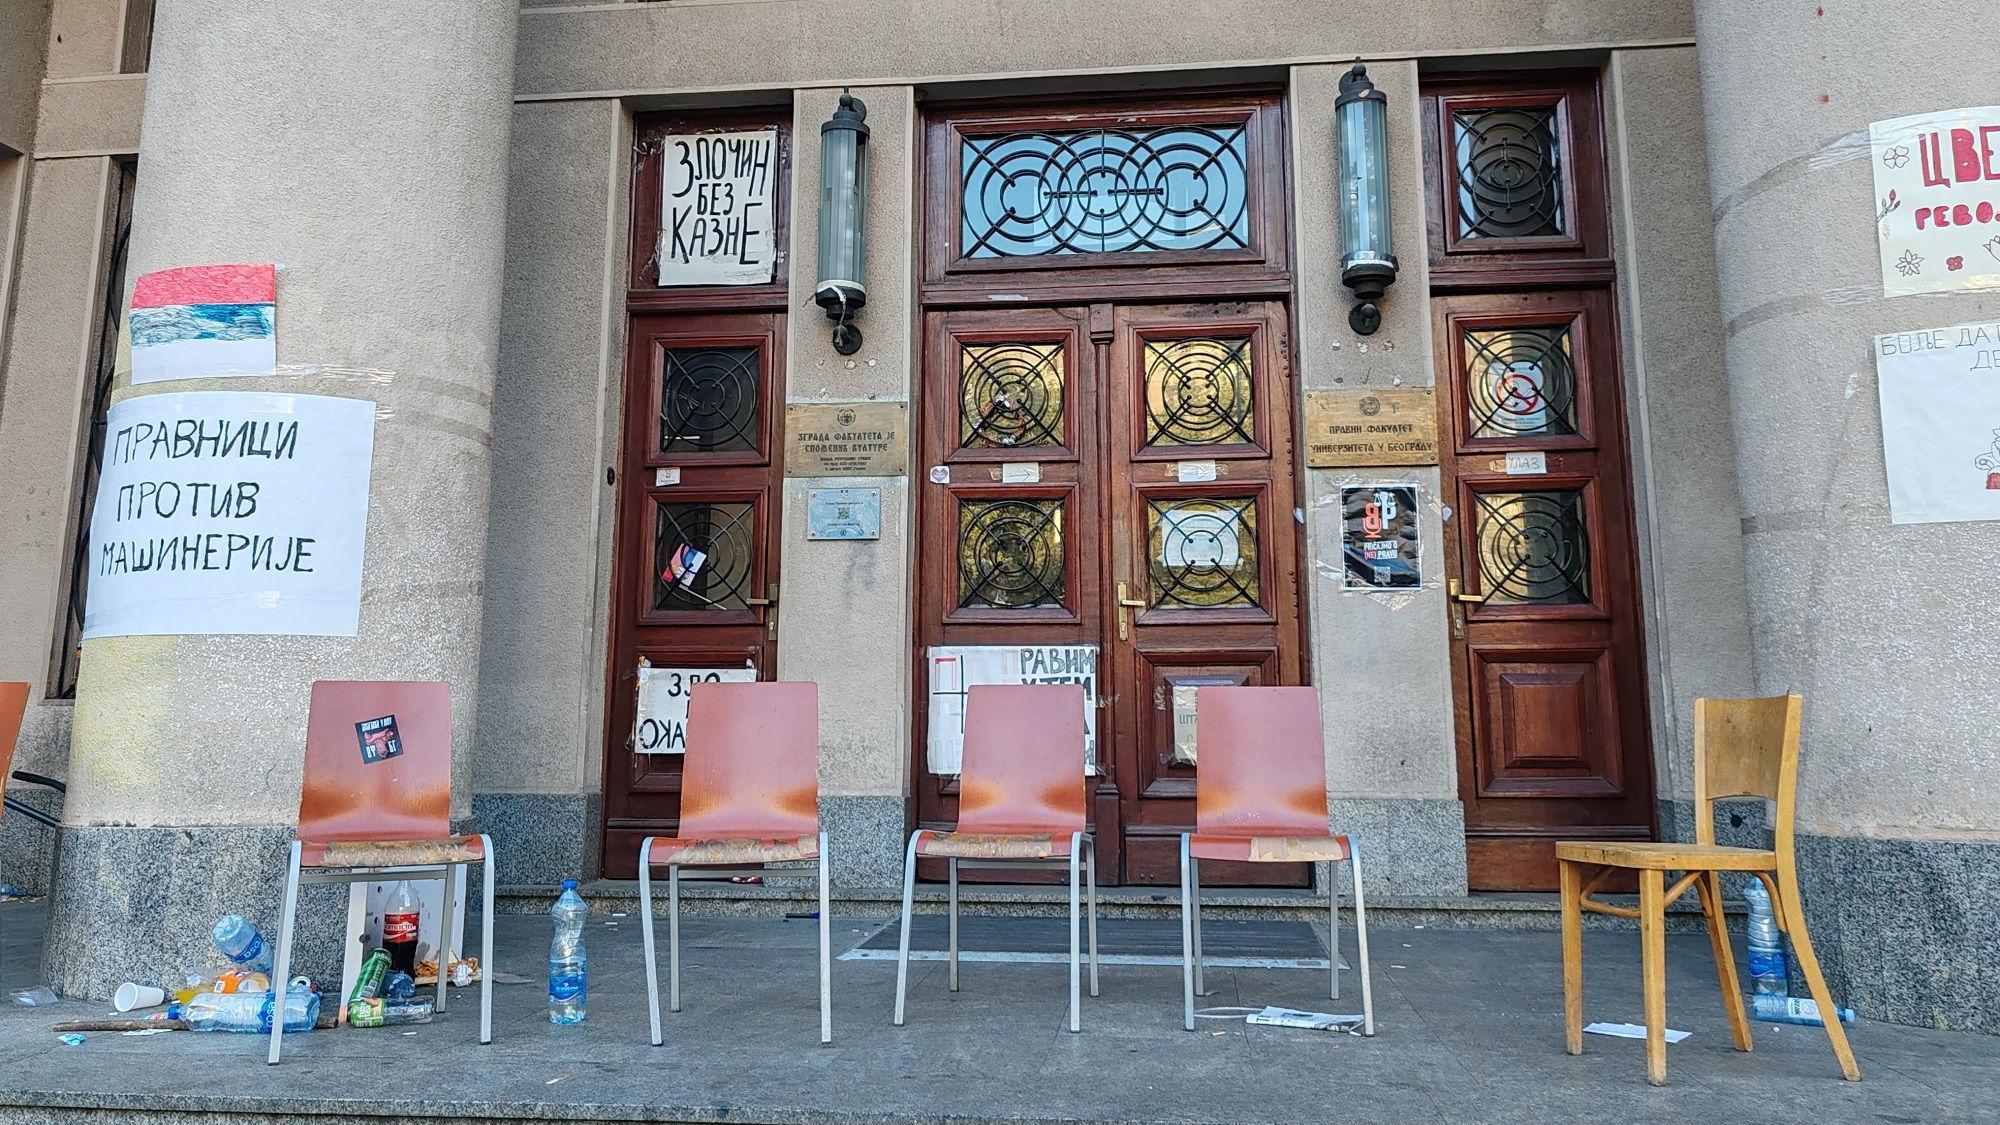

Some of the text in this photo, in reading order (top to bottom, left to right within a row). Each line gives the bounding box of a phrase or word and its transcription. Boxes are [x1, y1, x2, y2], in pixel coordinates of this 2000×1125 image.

[672, 137, 770, 197] ЗЛОЧИН
[697, 182, 734, 216] БЕЗ
[1915, 201, 2000, 230] РЕВО
[671, 202, 763, 265] КАЗНЕ
[1880, 327, 1991, 355] БОЉЕ ДА
[112, 419, 300, 466] ПРАВНИЦИ
[798, 432, 829, 442] ЗГРАДА
[834, 431, 882, 441] ФАКУЛТЕТА
[1329, 424, 1413, 434] ПРАВНИ ФАКУЛТЕТ
[805, 443, 888, 453] СПОМЕНИК КУЛТУРЕ
[1311, 442, 1432, 453] УНИВЕРЗИТЕТА У БЕОГРАДУ
[1508, 456, 1540, 470] УЛАЗ
[116, 480, 260, 523] ПРОТИВ
[99, 533, 316, 577] МАШИНЕРИЈЕ
